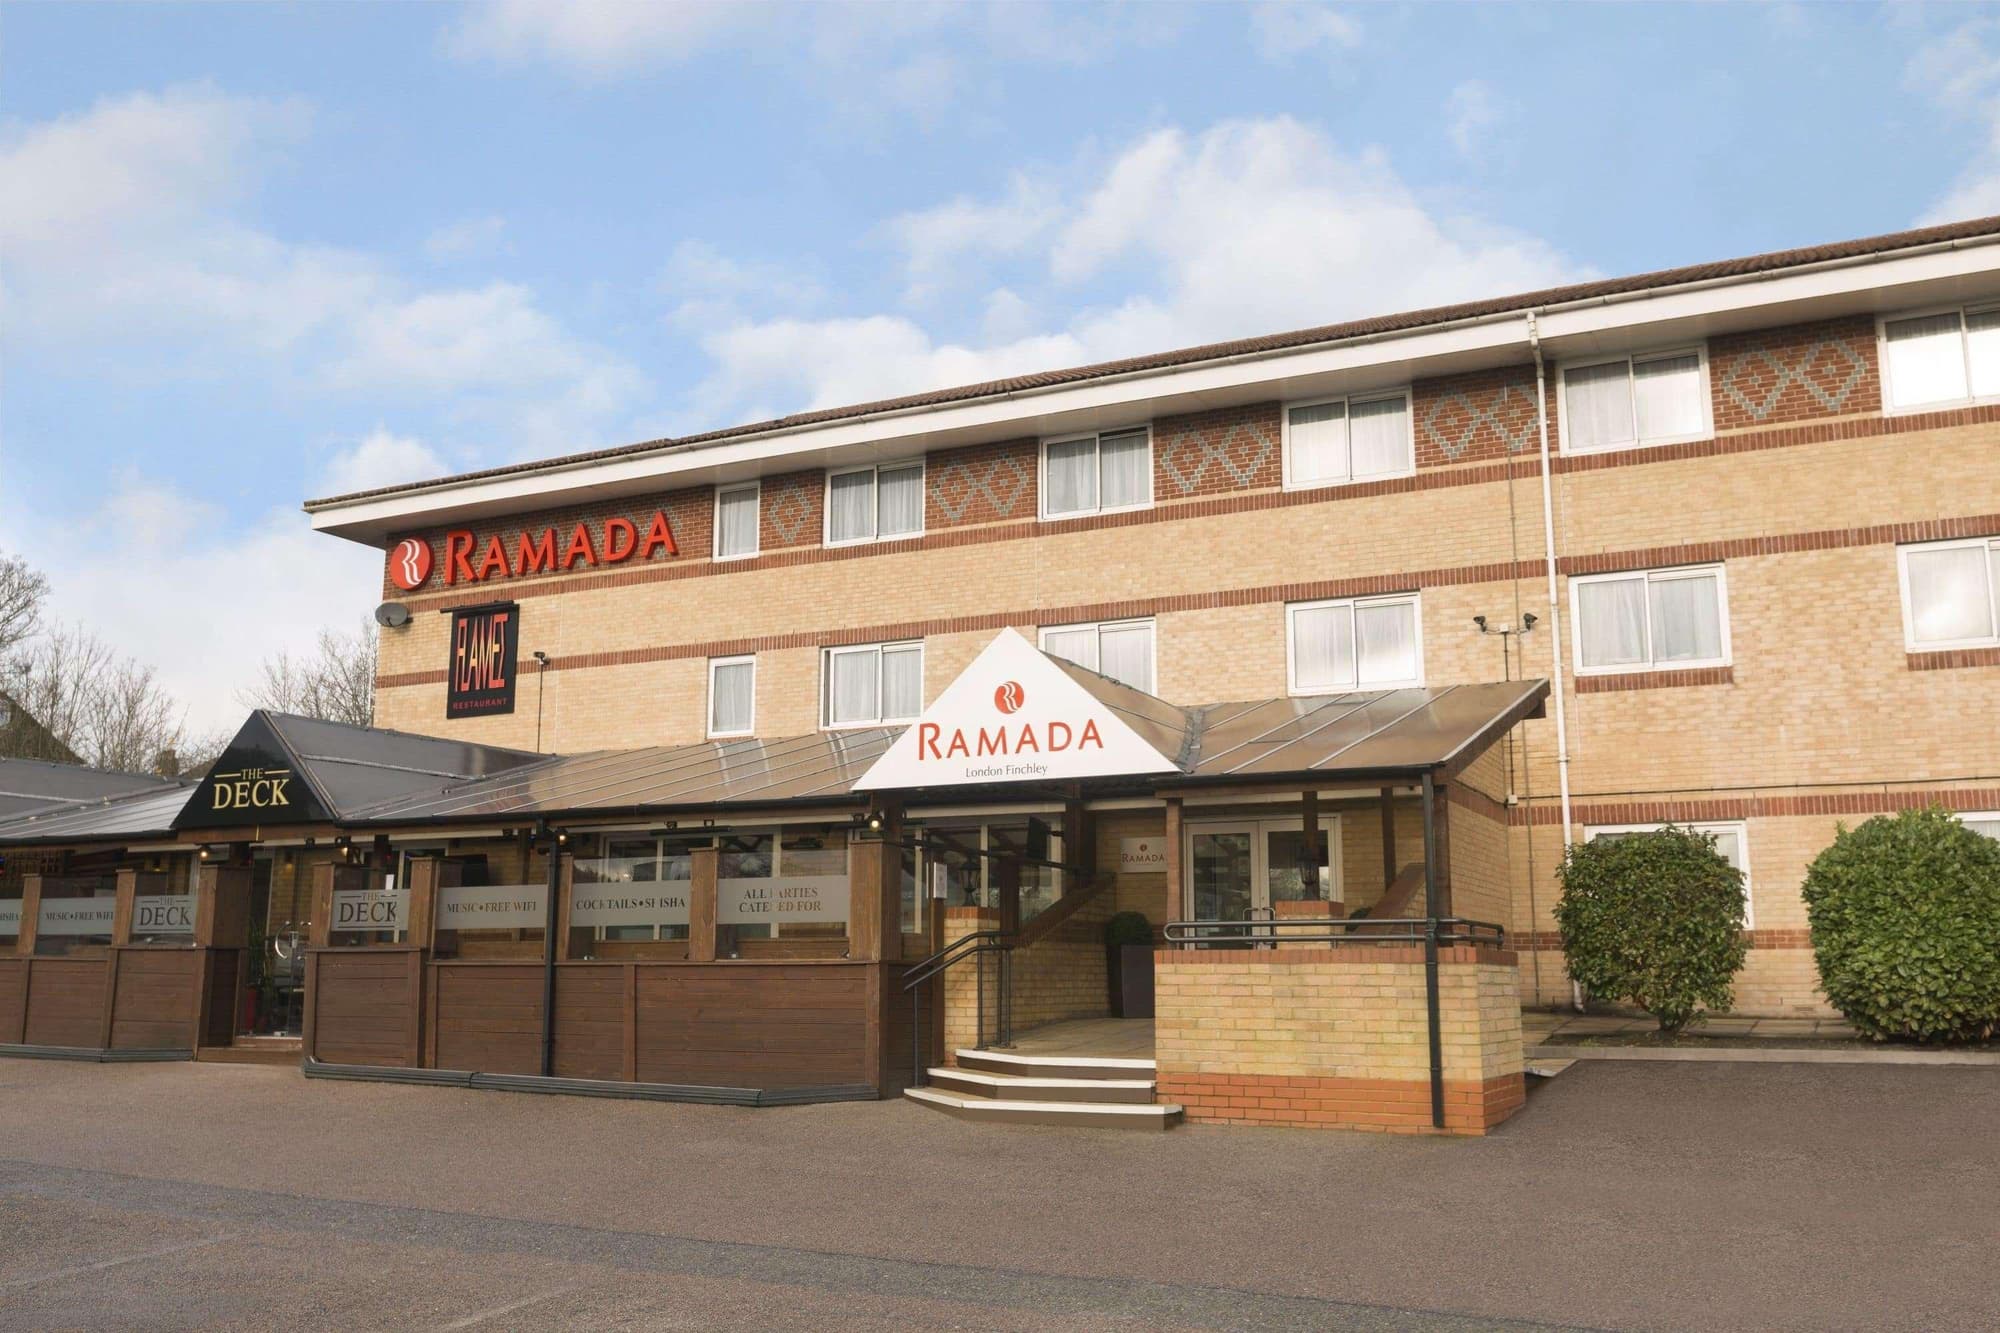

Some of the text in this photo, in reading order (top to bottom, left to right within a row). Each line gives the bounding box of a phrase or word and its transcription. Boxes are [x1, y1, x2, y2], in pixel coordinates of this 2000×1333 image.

[445, 511, 678, 585] RAMADA
[452, 698, 507, 711] RESTAURANT
[917, 718, 1104, 761] RAMADA
[241, 767, 264, 780] THE
[965, 762, 1048, 778] London Finchley
[212, 778, 290, 810] DECK
[1121, 852, 1165, 863] RAMADA
[361, 891, 380, 901] THE
[744, 888, 767, 900] ALL
[338, 901, 397, 923] DECK
[447, 901, 537, 914] MUSIC FREE WIFI
[739, 900, 822, 913] CATEED FOR
[138, 906, 192, 926] DECK
